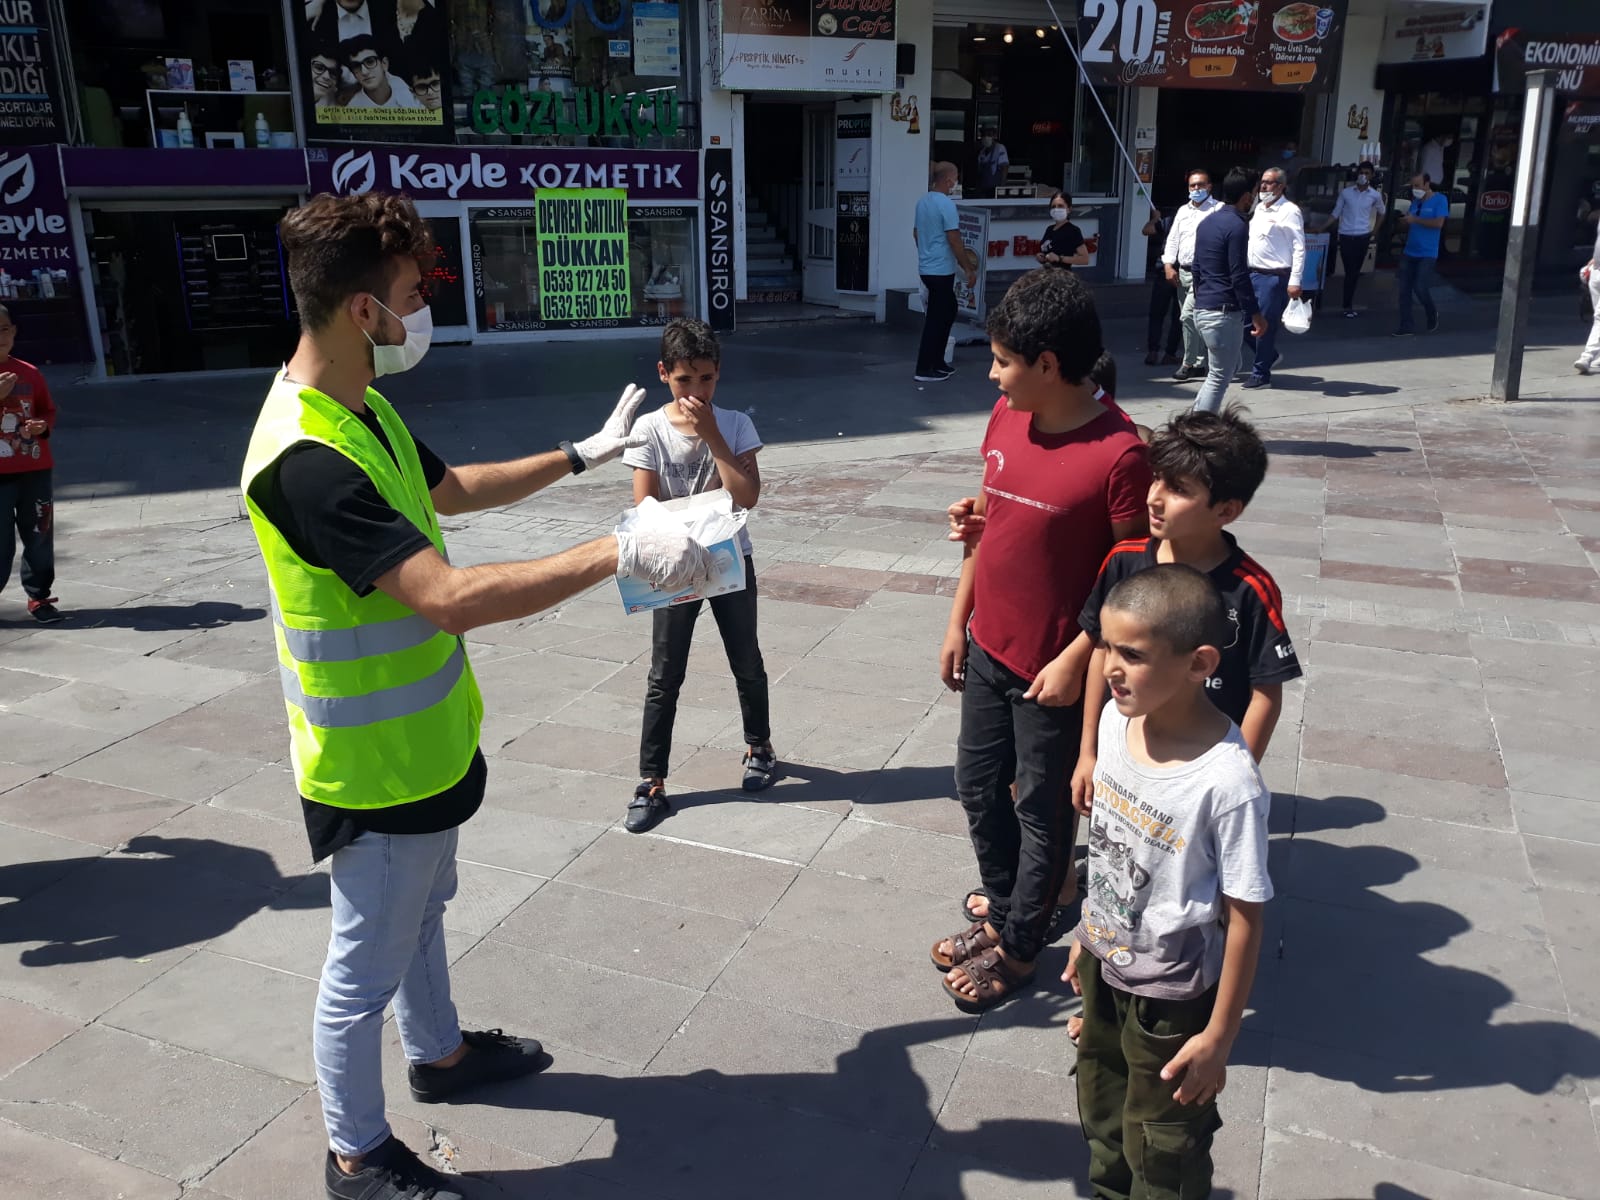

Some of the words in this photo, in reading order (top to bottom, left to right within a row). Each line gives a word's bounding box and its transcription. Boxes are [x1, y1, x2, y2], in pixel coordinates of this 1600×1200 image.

[842, 15, 893, 38] Cafe
[1155, 10, 1173, 45] YILA
[1226, 45, 1246, 56] Kola
[1304, 45, 1323, 54] Tavuk
[825, 66, 882, 77] musti
[1555, 65, 1584, 90] NÜ
[472, 83, 679, 147] GÖZLÜKÇÜ
[389, 152, 507, 198] Kayle
[0, 207, 67, 242] ayle
[538, 199, 582, 234] DEVREN
[584, 198, 626, 233] SATILIK
[542, 235, 625, 267] DÜKKAN
[543, 269, 574, 292] 0533
[575, 269, 594, 292] 127
[595, 269, 610, 291] 24
[611, 268, 626, 291] 50
[543, 295, 574, 319] 0532
[575, 294, 598, 318] 550
[599, 294, 612, 317] 12
[613, 293, 628, 316] 02
[1101, 771, 1139, 804] LEGENDARY
[1139, 801, 1174, 825] BRAND
[1095, 780, 1186, 854] OTORCYCLE
[1143, 837, 1176, 857] DEALER
